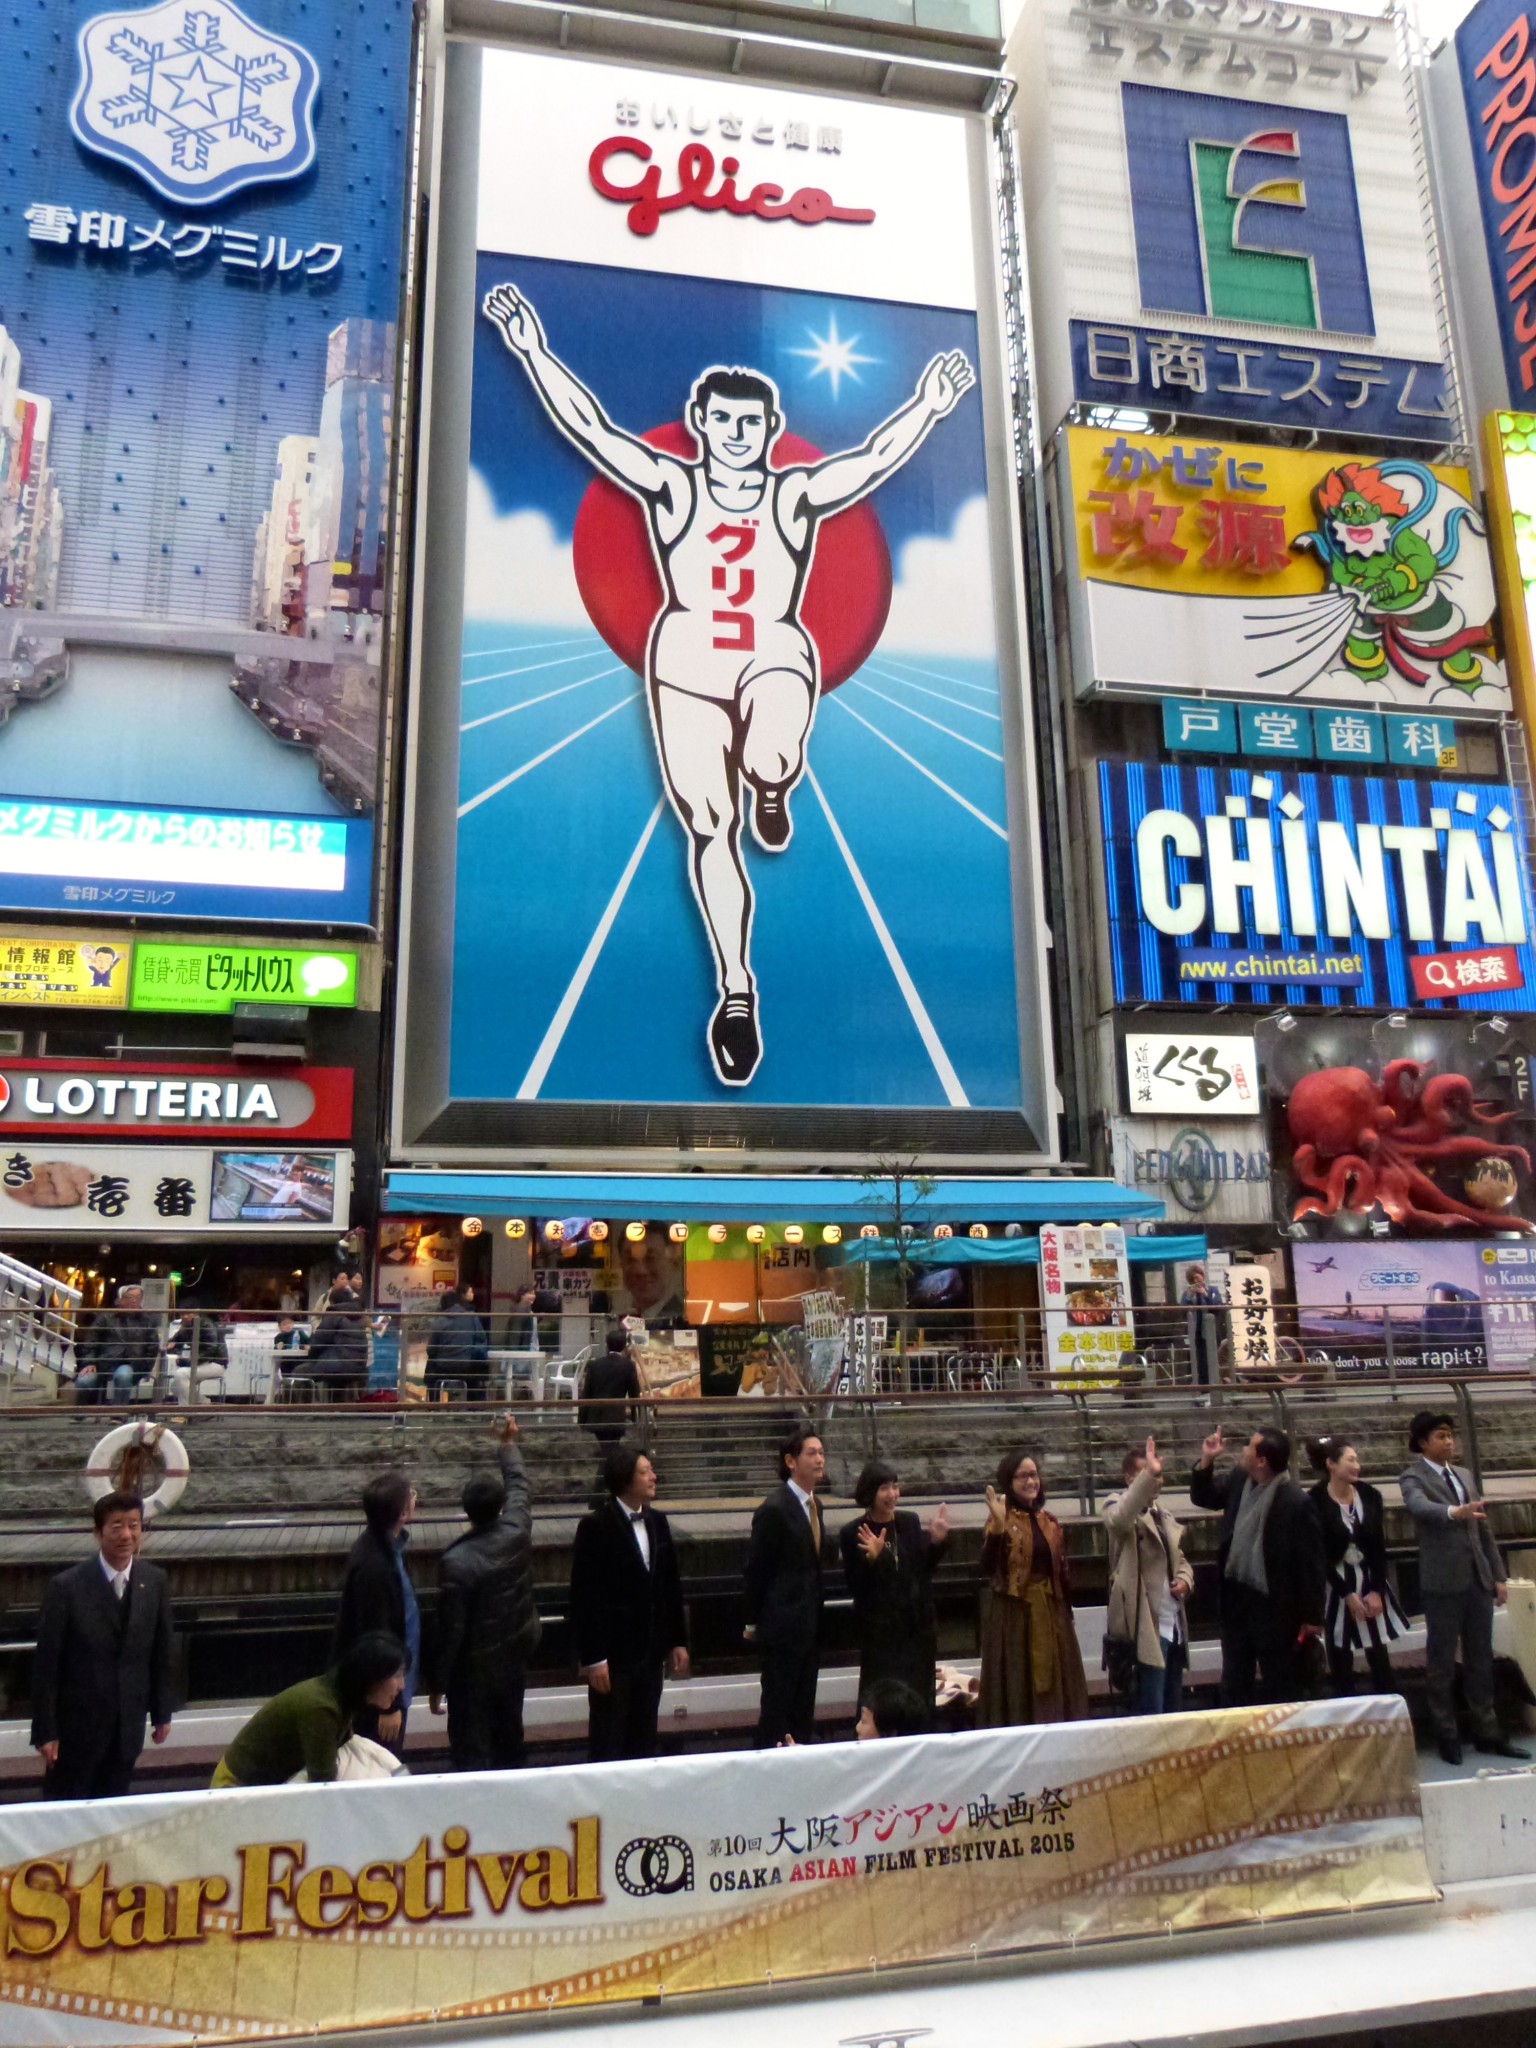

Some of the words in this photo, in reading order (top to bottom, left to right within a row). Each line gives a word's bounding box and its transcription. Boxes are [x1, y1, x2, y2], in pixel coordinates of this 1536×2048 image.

[1088, 22, 1378, 97] エステムコート
[614, 98, 843, 154] おいしさと健康
[24, 202, 343, 275] 雪印メグミルク
[1087, 328, 1450, 419] 日商エステム
[1101, 437, 1268, 494] かぜに
[1088, 489, 1292, 575] 改源
[705, 518, 760, 652] グリコ
[1178, 706, 1444, 758] 戸堂歯科
[1441, 751, 1455, 765] 3F
[63, 885, 176, 905] 雪印メグミルク
[0, 963, 74, 974] 総合プロデュース
[206, 953, 294, 994] ピタットハウス
[1456, 956, 1507, 986] 検索
[25, 1077, 279, 1120] LOTTERIA
[1152, 1044, 1232, 1102] くくる
[1042, 1231, 1061, 1295] 大阪名物
[1485, 1274, 1497, 1286] to
[1499, 1270, 1536, 1286] Kansa
[1335, 1355, 1361, 1368] don't
[1364, 1357, 1382, 1370] you
[708, 1834, 762, 1857] 第10回
[766, 1786, 1073, 1856] 大阪アジアン映画祭
[7, 1860, 228, 1960] Star
[234, 1815, 606, 1939] Festival
[709, 1867, 783, 1893] OSAKA
[789, 1856, 857, 1883] ASIAN
[864, 1849, 917, 1874] FILM
[924, 1838, 1024, 1868] FESTIVAL
[1030, 1832, 1075, 1855] 2015
